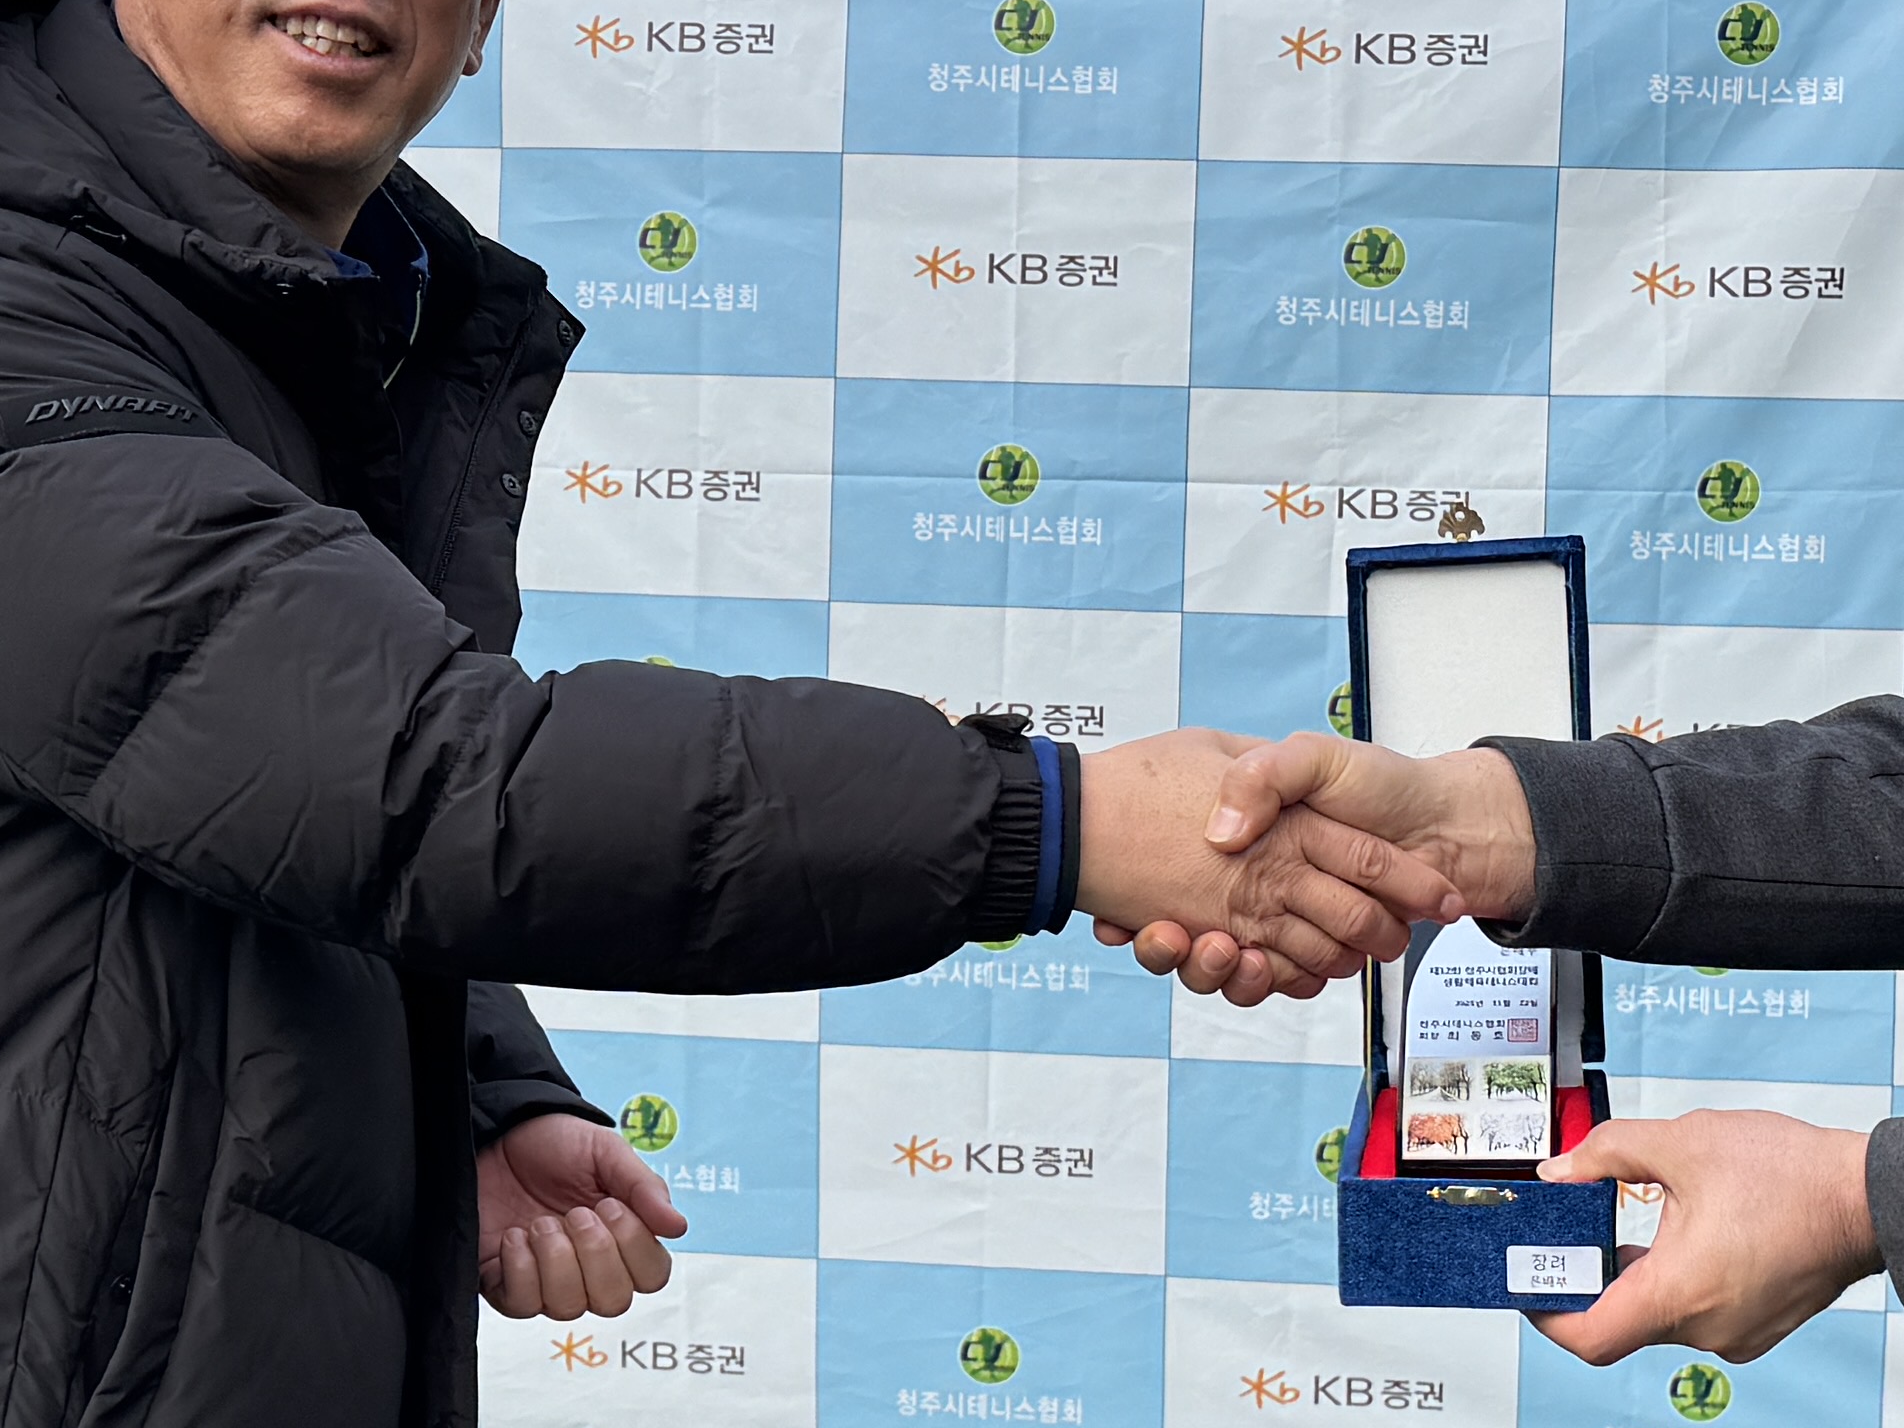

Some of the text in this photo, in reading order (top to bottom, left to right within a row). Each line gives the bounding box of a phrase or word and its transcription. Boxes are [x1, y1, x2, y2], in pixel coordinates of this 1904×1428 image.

[929, 63, 1118, 95] 청주시테니스협회
[1648, 74, 1845, 109] 청주시테니스협회
[574, 279, 758, 314] 청주시테니스협회
[1276, 293, 1469, 329] 청주시테니스협회
[24, 395, 197, 424] DYNAFIT
[913, 511, 1102, 546] 청주시테니스협회
[1630, 530, 1826, 564] 청주시테니스협회
[1614, 982, 1810, 1019] 청주시테니스협회
[897, 1387, 1083, 1424] 청주시테니스협회
